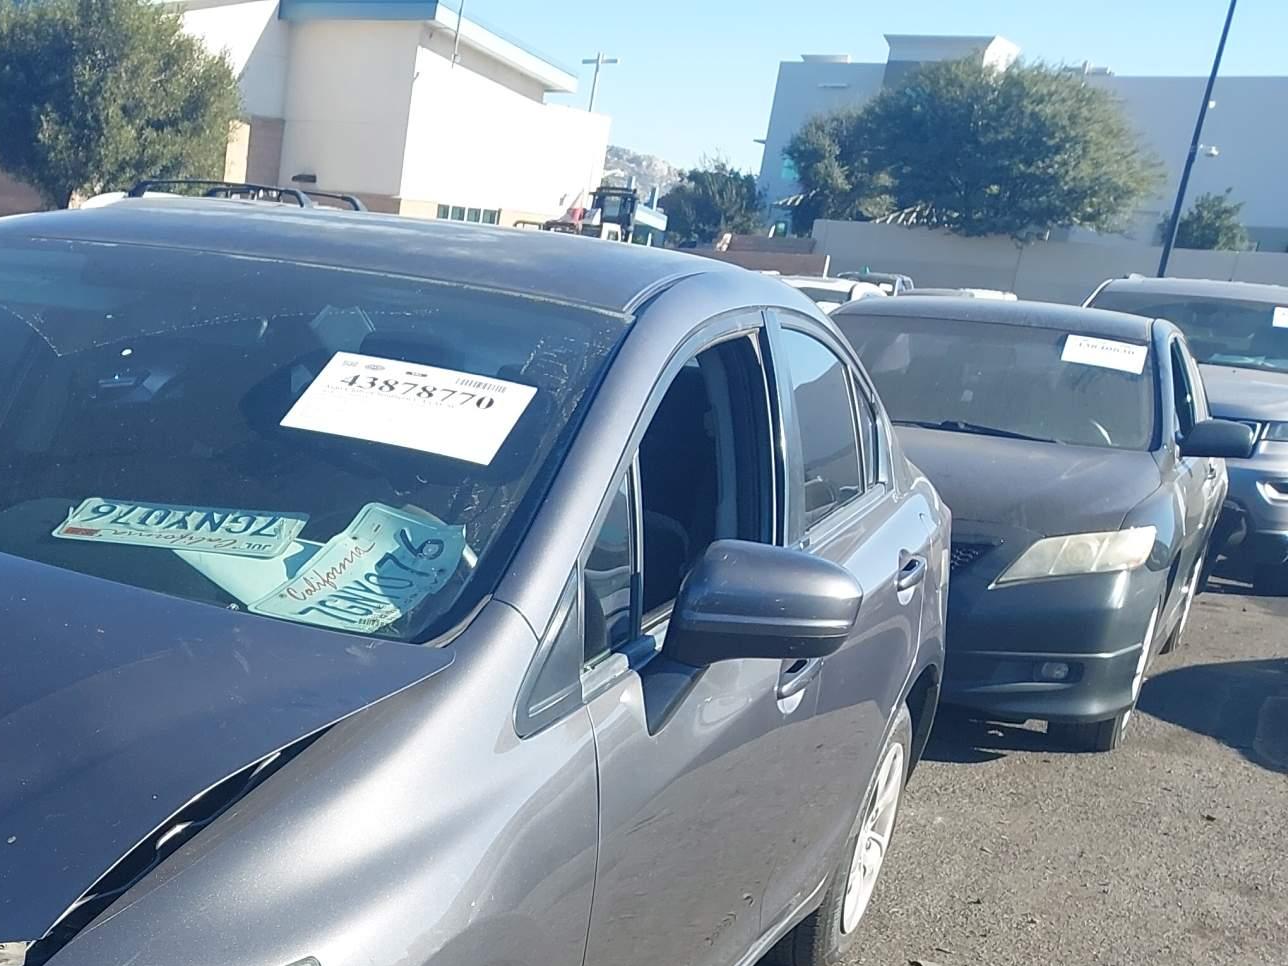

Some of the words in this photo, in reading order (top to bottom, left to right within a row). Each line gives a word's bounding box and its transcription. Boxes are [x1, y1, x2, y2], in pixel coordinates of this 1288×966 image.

[340, 373, 495, 410] 43878770
[79, 503, 280, 538] 7GNY076
[105, 529, 239, 550] California
[286, 543, 376, 601] California
[298, 528, 445, 624] 7GNY076
